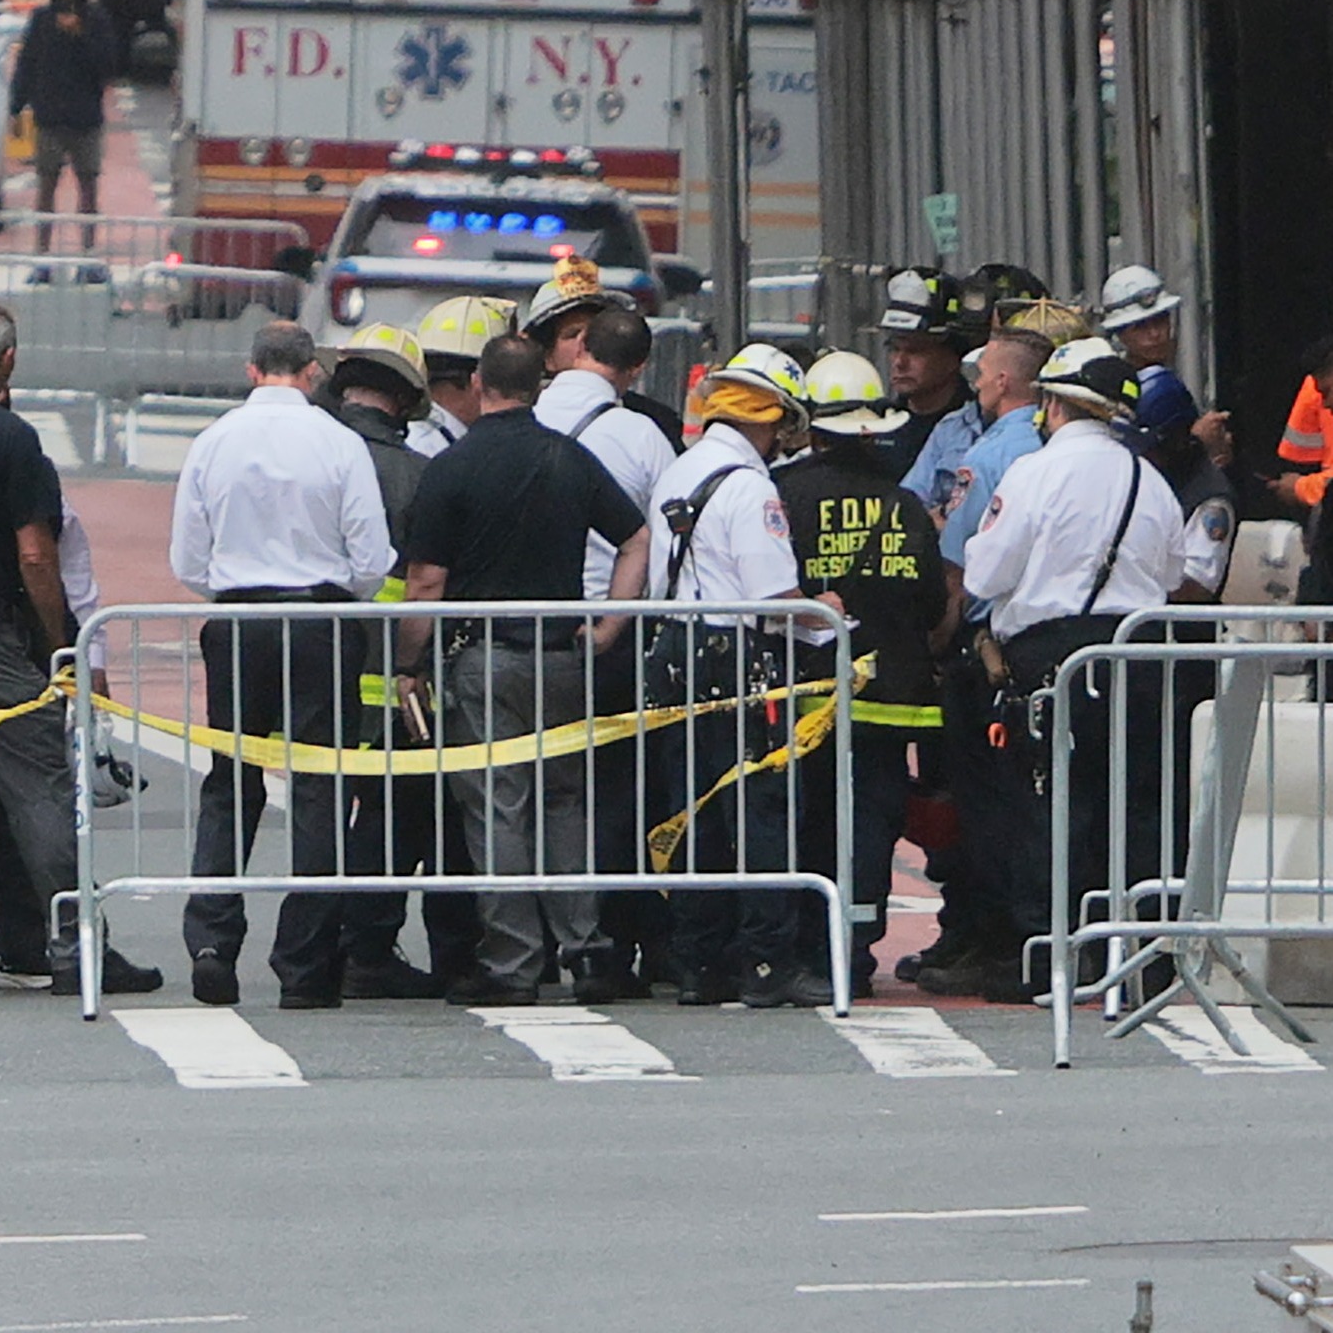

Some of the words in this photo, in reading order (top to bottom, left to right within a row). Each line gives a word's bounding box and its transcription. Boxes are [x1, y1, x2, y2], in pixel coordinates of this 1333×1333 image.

[232, 26, 345, 79] F.D.
[525, 35, 643, 88] N.Y.
[817, 530, 870, 555] CHIEF
[880, 532, 907, 554] OF
